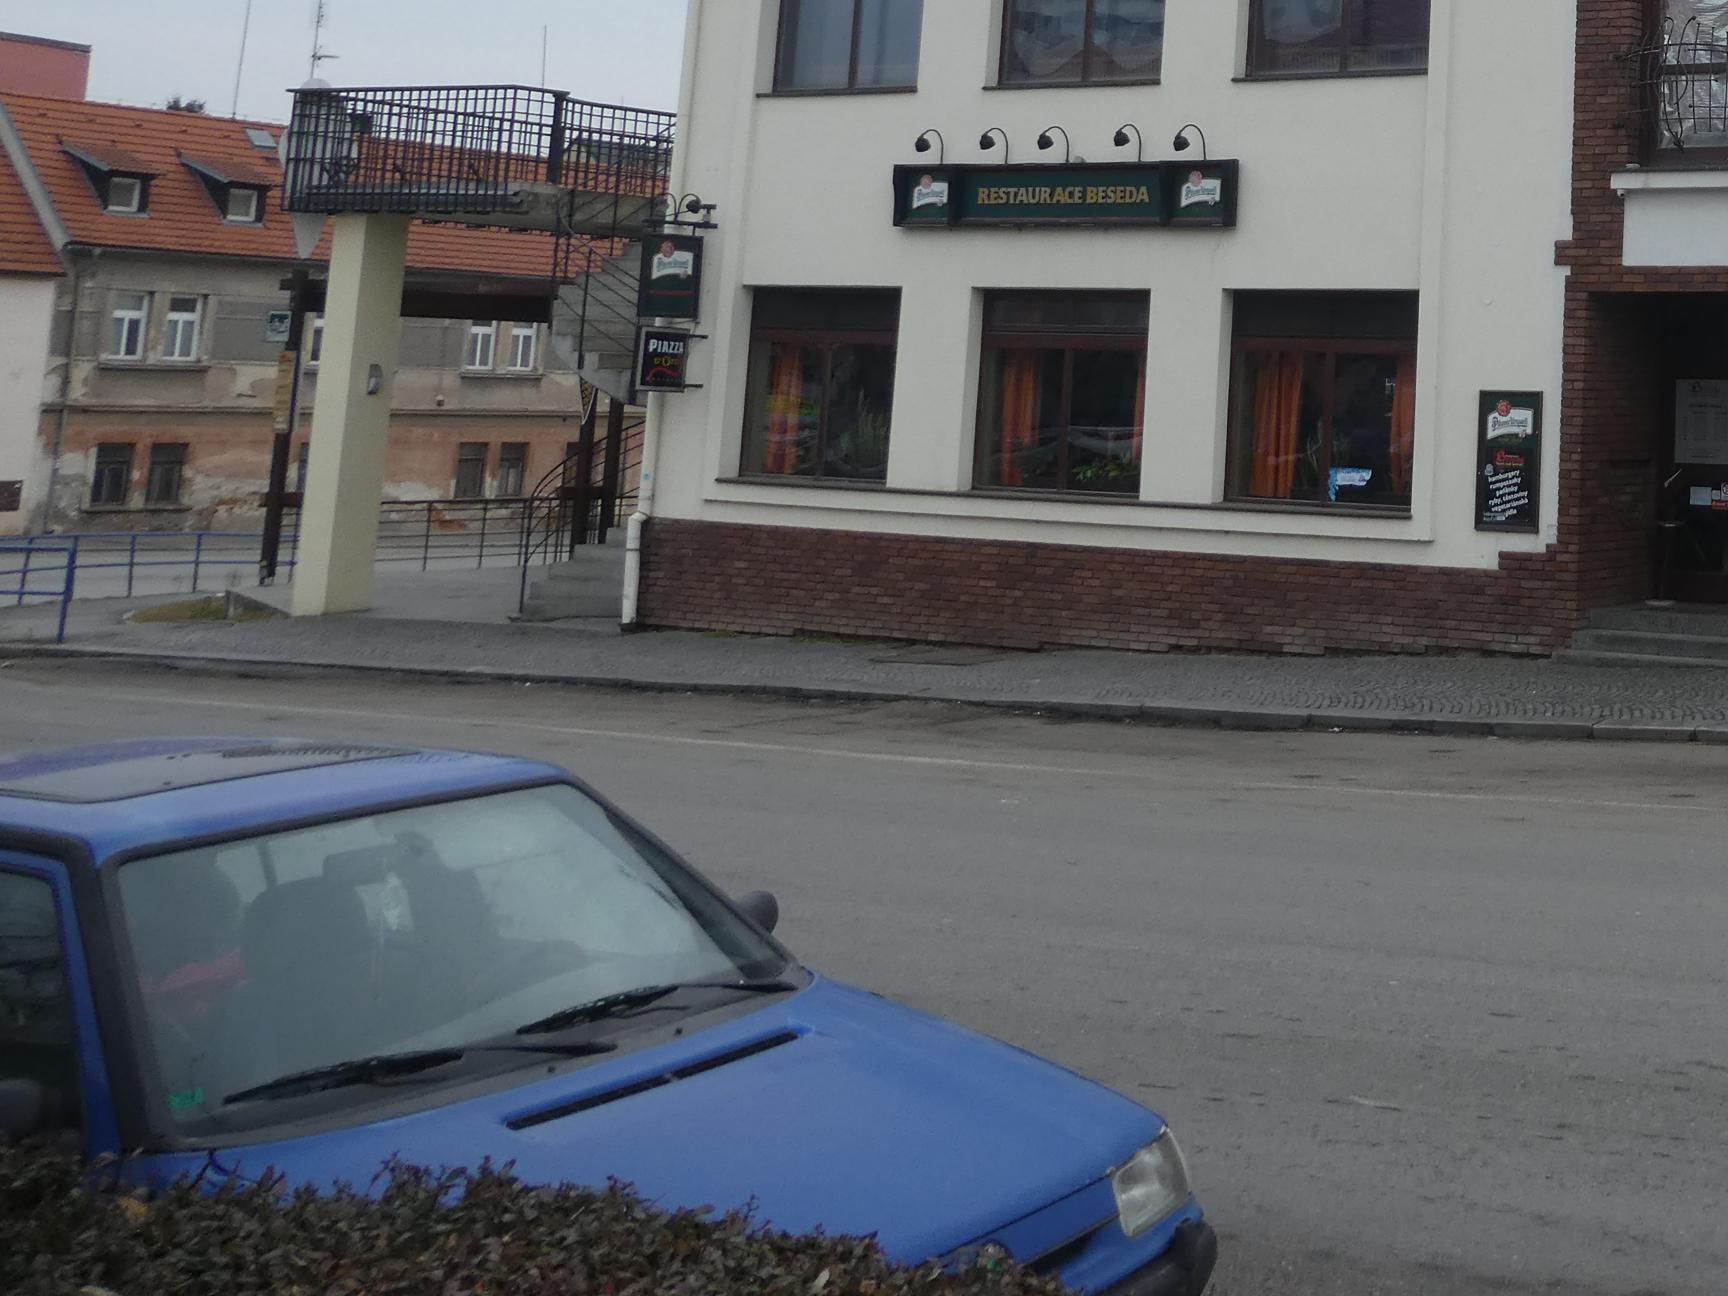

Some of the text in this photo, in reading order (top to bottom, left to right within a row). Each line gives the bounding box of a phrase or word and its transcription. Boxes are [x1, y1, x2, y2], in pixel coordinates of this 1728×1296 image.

[977, 186, 1149, 205] RESTAURACE BESEDA
[649, 338, 684, 353] PIAZZA
